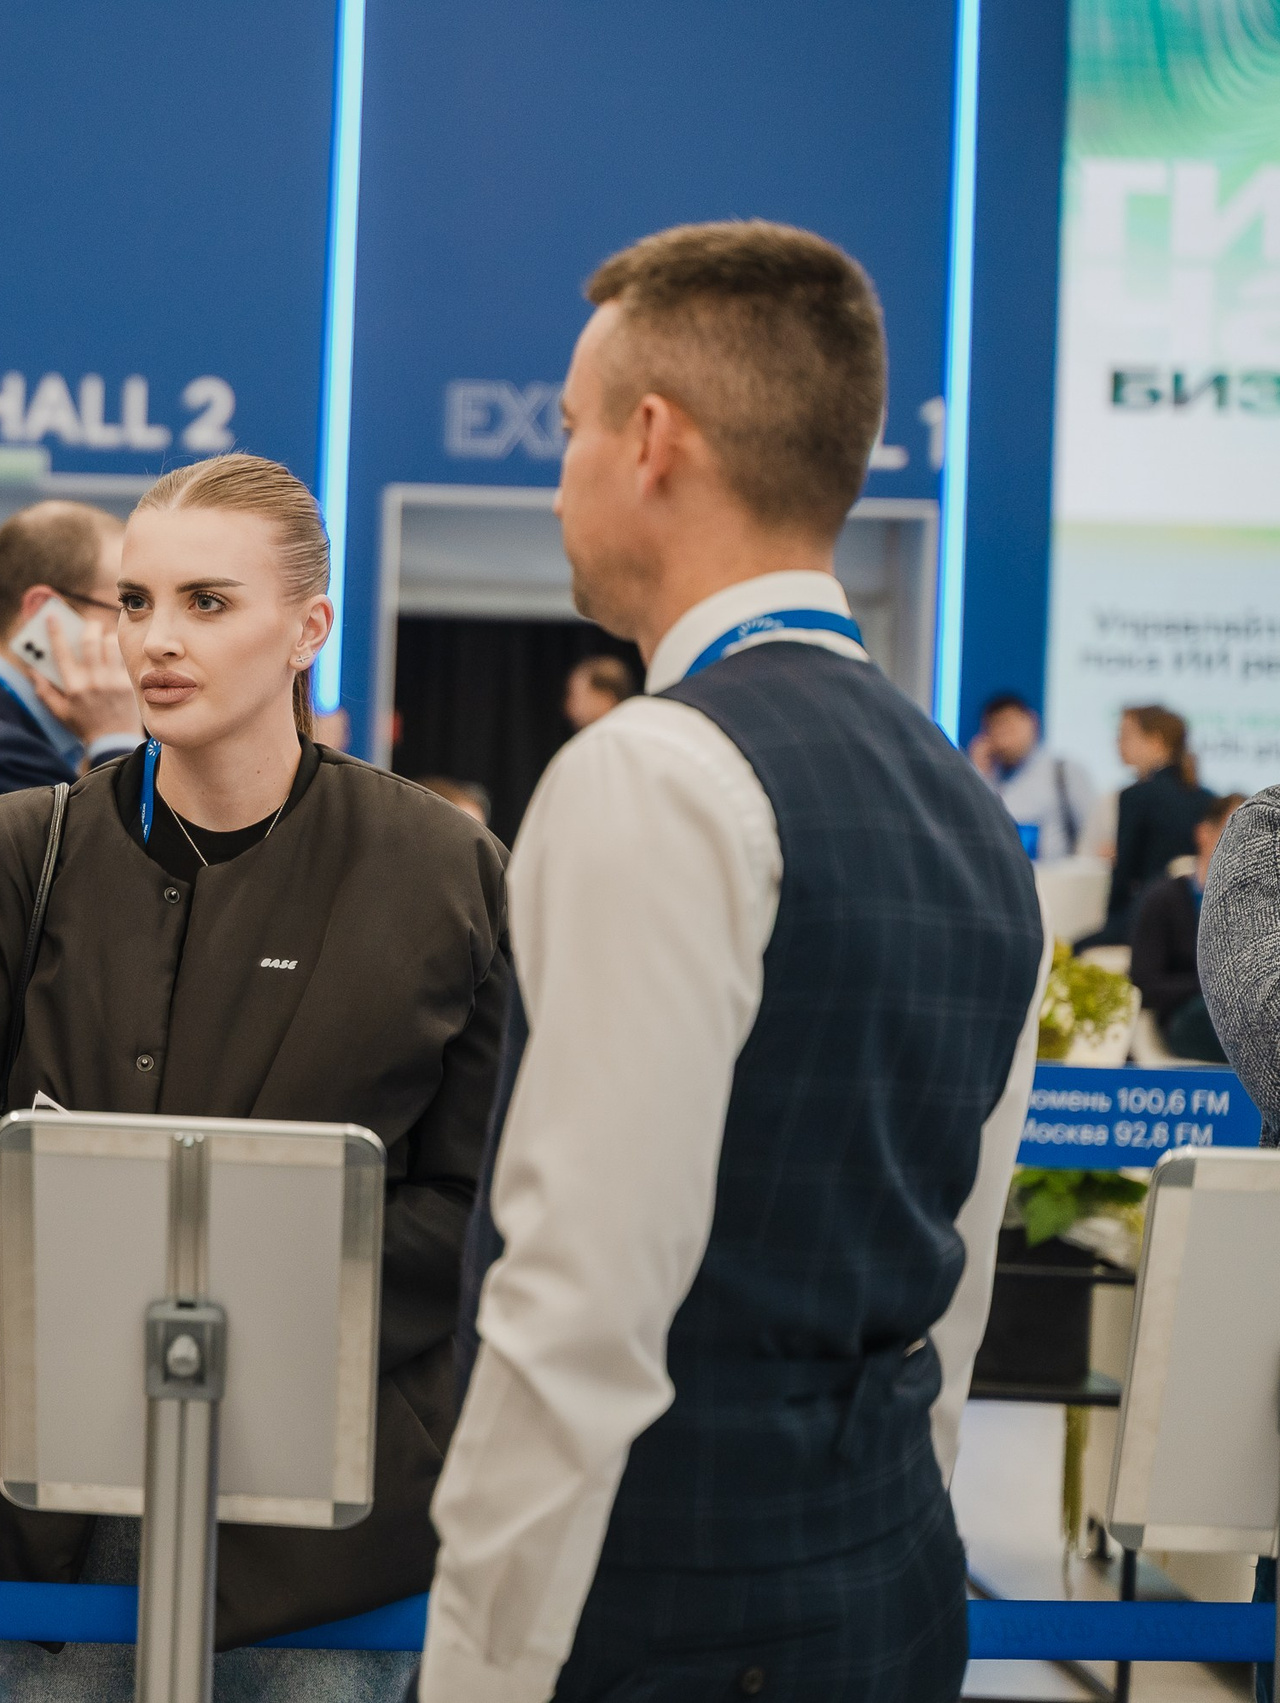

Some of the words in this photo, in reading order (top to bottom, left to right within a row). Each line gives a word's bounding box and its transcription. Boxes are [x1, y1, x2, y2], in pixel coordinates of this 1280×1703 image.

[1080, 156, 1280, 258] ГИ
[181, 374, 236, 451] 2
[444, 379, 568, 460] EX
[1110, 363, 1280, 413] БИЗ
[1030, 1088, 1112, 1113] юмень
[1117, 1087, 1186, 1117] 100,6
[1191, 1088, 1230, 1116] FM
[1114, 1119, 1170, 1149] 92,8
[1174, 1122, 1213, 1147] FM
